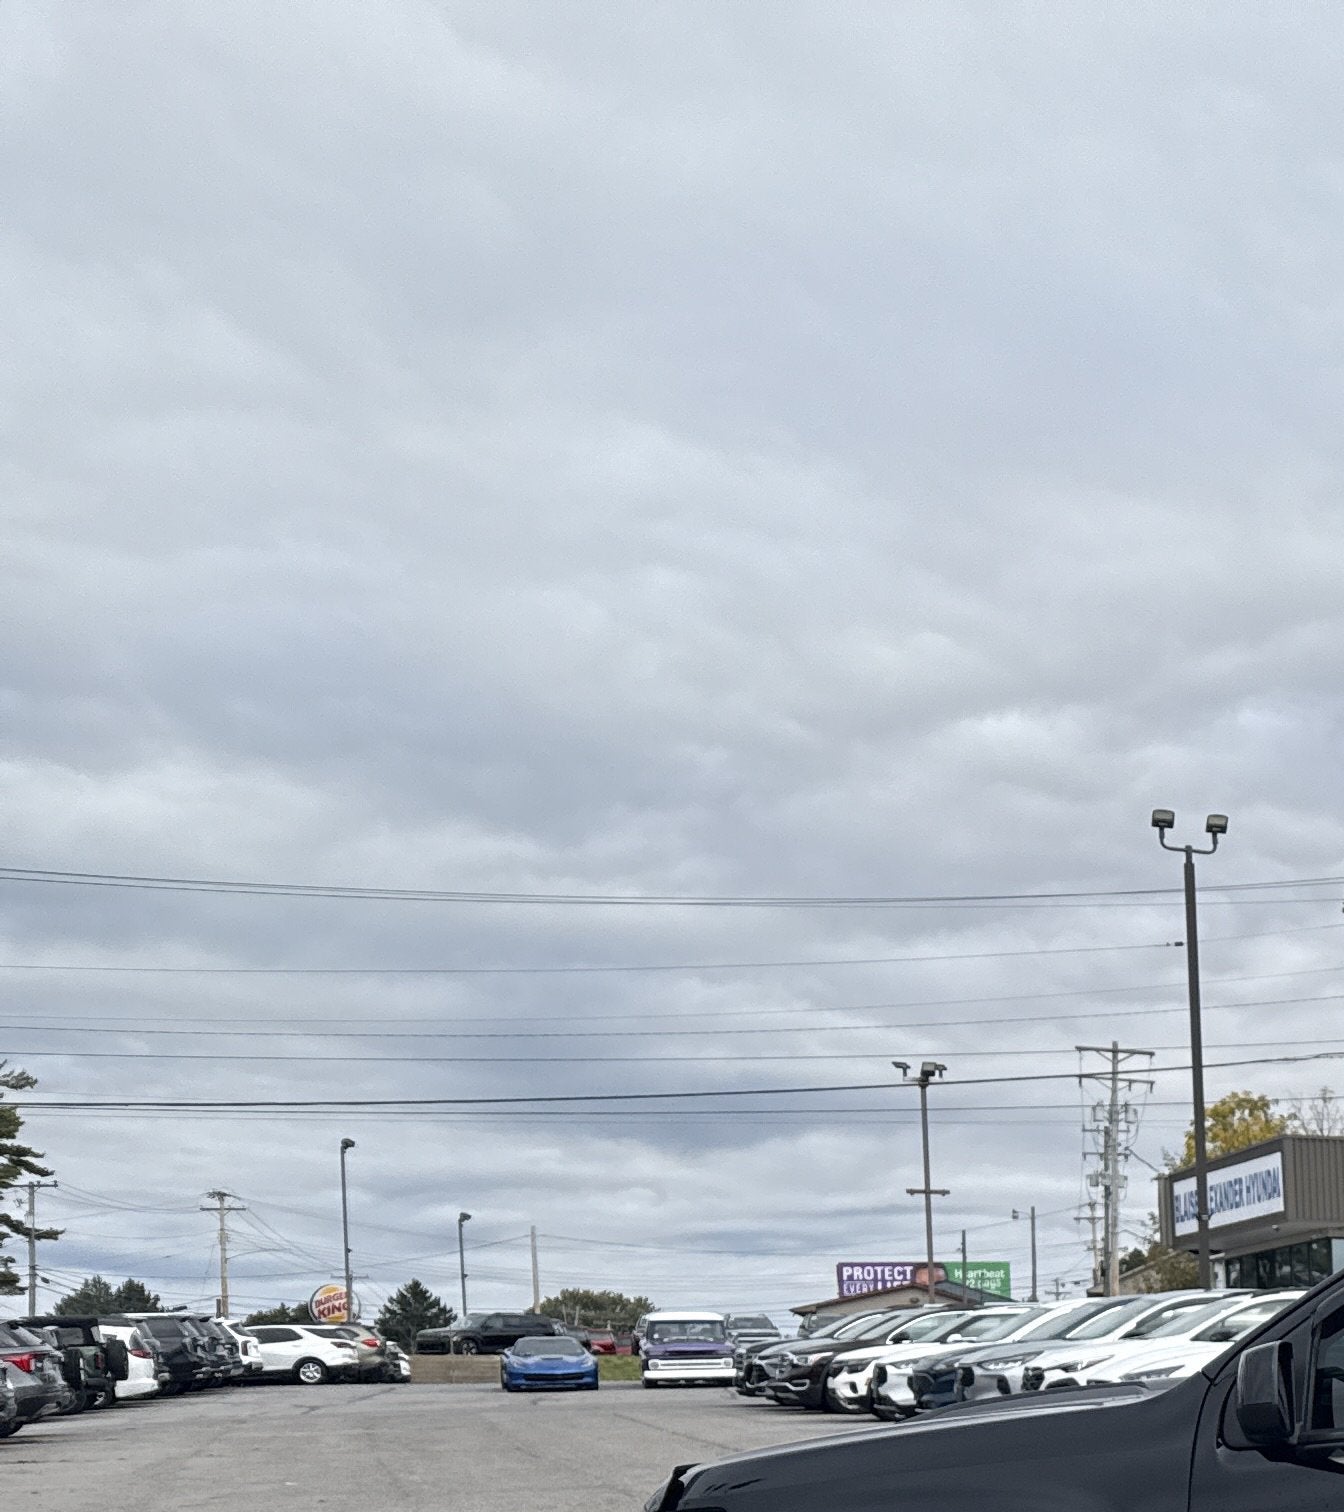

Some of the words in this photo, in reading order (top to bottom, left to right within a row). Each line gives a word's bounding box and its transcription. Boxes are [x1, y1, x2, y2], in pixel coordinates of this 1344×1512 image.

[1209, 1177, 1245, 1214] EXANDER
[1245, 1166, 1281, 1206] HYUNDAI
[843, 1266, 913, 1280] PROTECT
[955, 1268, 1005, 1279] Hartbeat
[843, 1282, 874, 1295] EVERY
[315, 1291, 348, 1308] BURGE
[318, 1302, 350, 1319] KING
